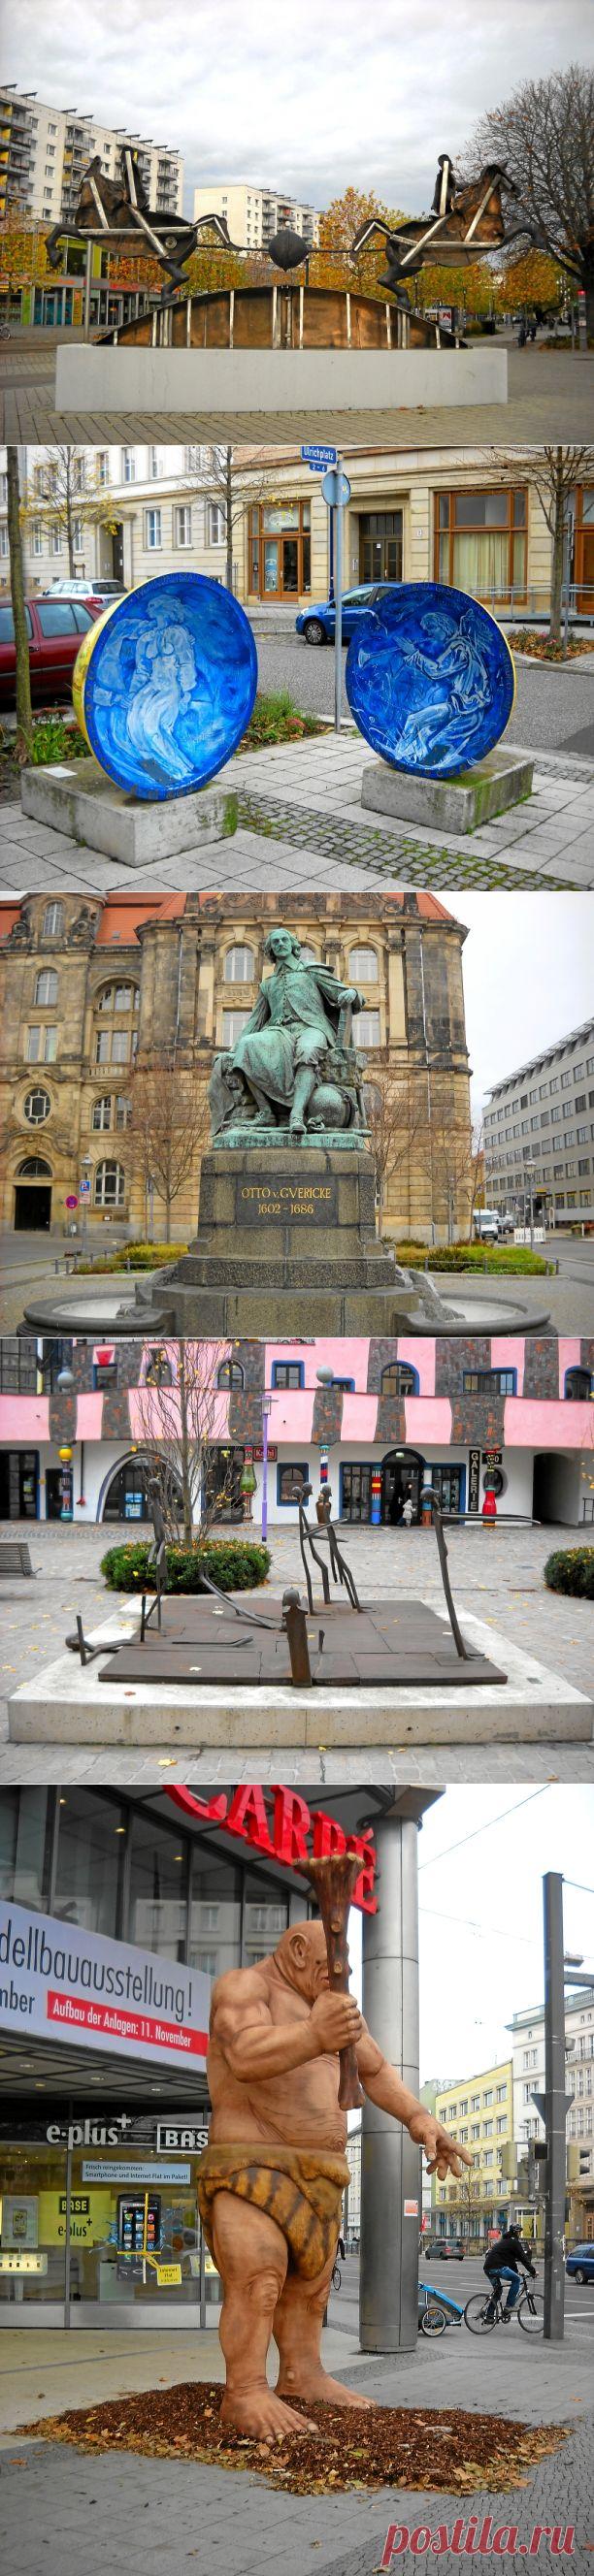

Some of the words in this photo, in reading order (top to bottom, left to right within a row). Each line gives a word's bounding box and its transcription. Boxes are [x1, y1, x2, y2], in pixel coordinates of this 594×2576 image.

[241, 1187, 271, 1199] OTTO
[280, 1187, 331, 1199] GVERICKE
[258, 1204, 281, 1215] 1602
[290, 1204, 314, 1215] 1686
[470, 1452, 478, 1510] GALERIE
[0, 1918, 192, 2023] dellbauausstellung!
[52, 1998, 85, 2022] Aufbau
[87, 2011, 101, 2026] der
[103, 2015, 139, 2036] Anlagen:
[141, 2021, 153, 2039] 11.
[155, 2024, 191, 2047] November
[61, 2200, 87, 2211] BASE
